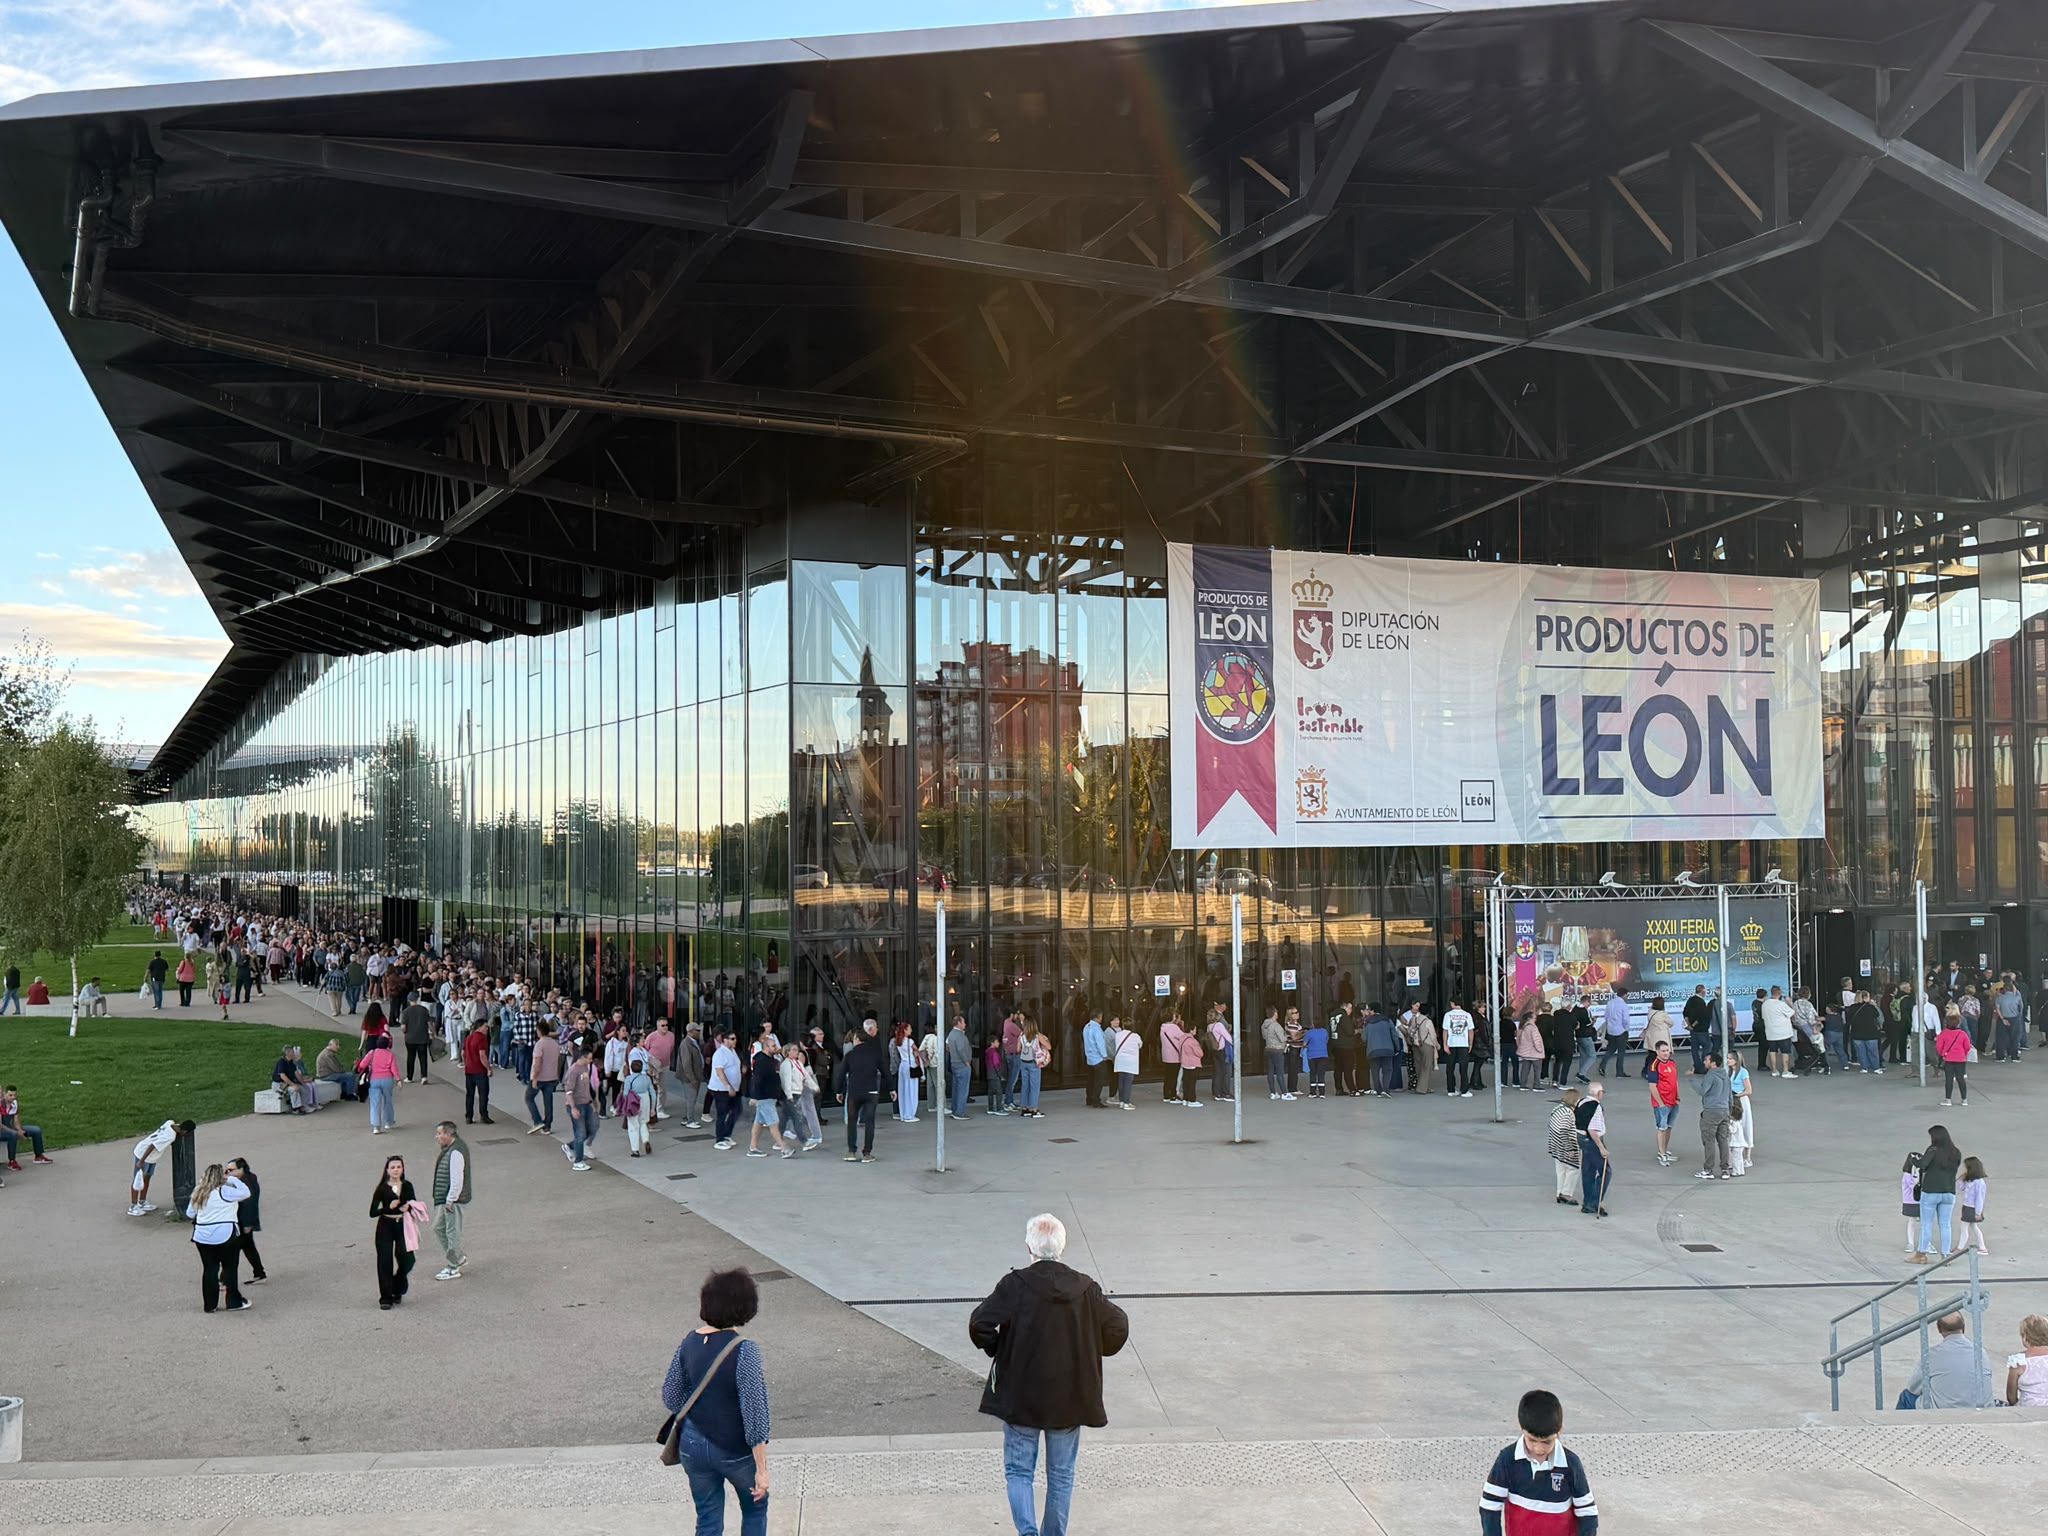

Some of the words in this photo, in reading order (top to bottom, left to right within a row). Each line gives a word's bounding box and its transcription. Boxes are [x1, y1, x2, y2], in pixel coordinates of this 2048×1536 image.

[1198, 592, 1254, 605] PRODUCTOS
[1256, 595, 1268, 606] DE
[1199, 605, 1268, 643] LEÓN
[1342, 611, 1440, 631] DIPUTACIÓN
[1342, 633, 1362, 648] DE
[1367, 630, 1409, 650] LEÓN
[1535, 614, 1729, 658] PRODUCTOS
[1739, 622, 1775, 658] DE
[1540, 660, 1773, 798] LEÓN
[1464, 793, 1492, 806] LEÓN
[1335, 808, 1414, 819] AYUNTAMIENTO
[1416, 808, 1430, 818] DE
[1432, 804, 1458, 818] LEÓN
[1515, 922, 1535, 934] LEÓN
[1646, 920, 1677, 936] XXXII
[1680, 918, 1716, 935] FERIA
[1643, 937, 1719, 955] PRODUCTOS
[1655, 957, 1673, 973] DE
[1675, 952, 1709, 972] LEÓN
[1739, 957, 1764, 966] REINO
